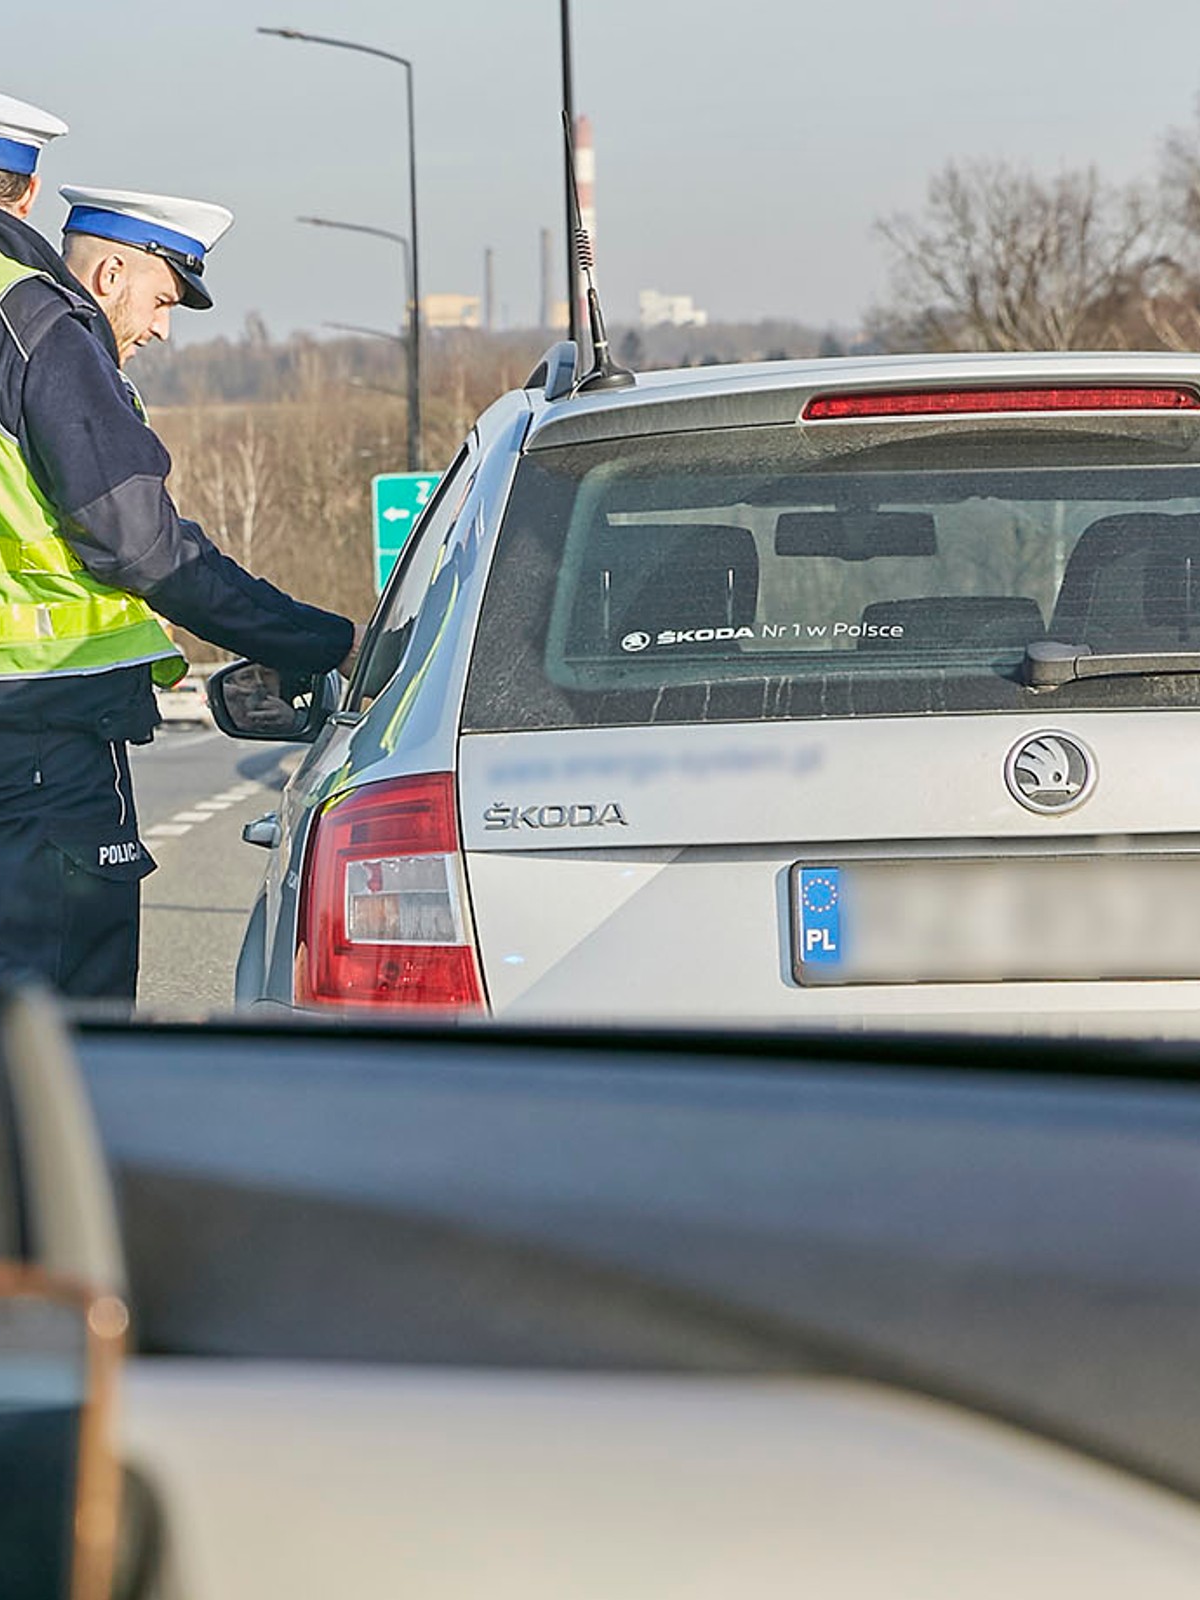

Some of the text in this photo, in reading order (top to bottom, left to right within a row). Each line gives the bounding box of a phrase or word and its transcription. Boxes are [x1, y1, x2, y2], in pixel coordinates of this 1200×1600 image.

[656, 622, 905, 646] ŠKODA Nr 1 w Polsce
[482, 801, 629, 832] ŠKODA
[806, 928, 837, 952] PL
